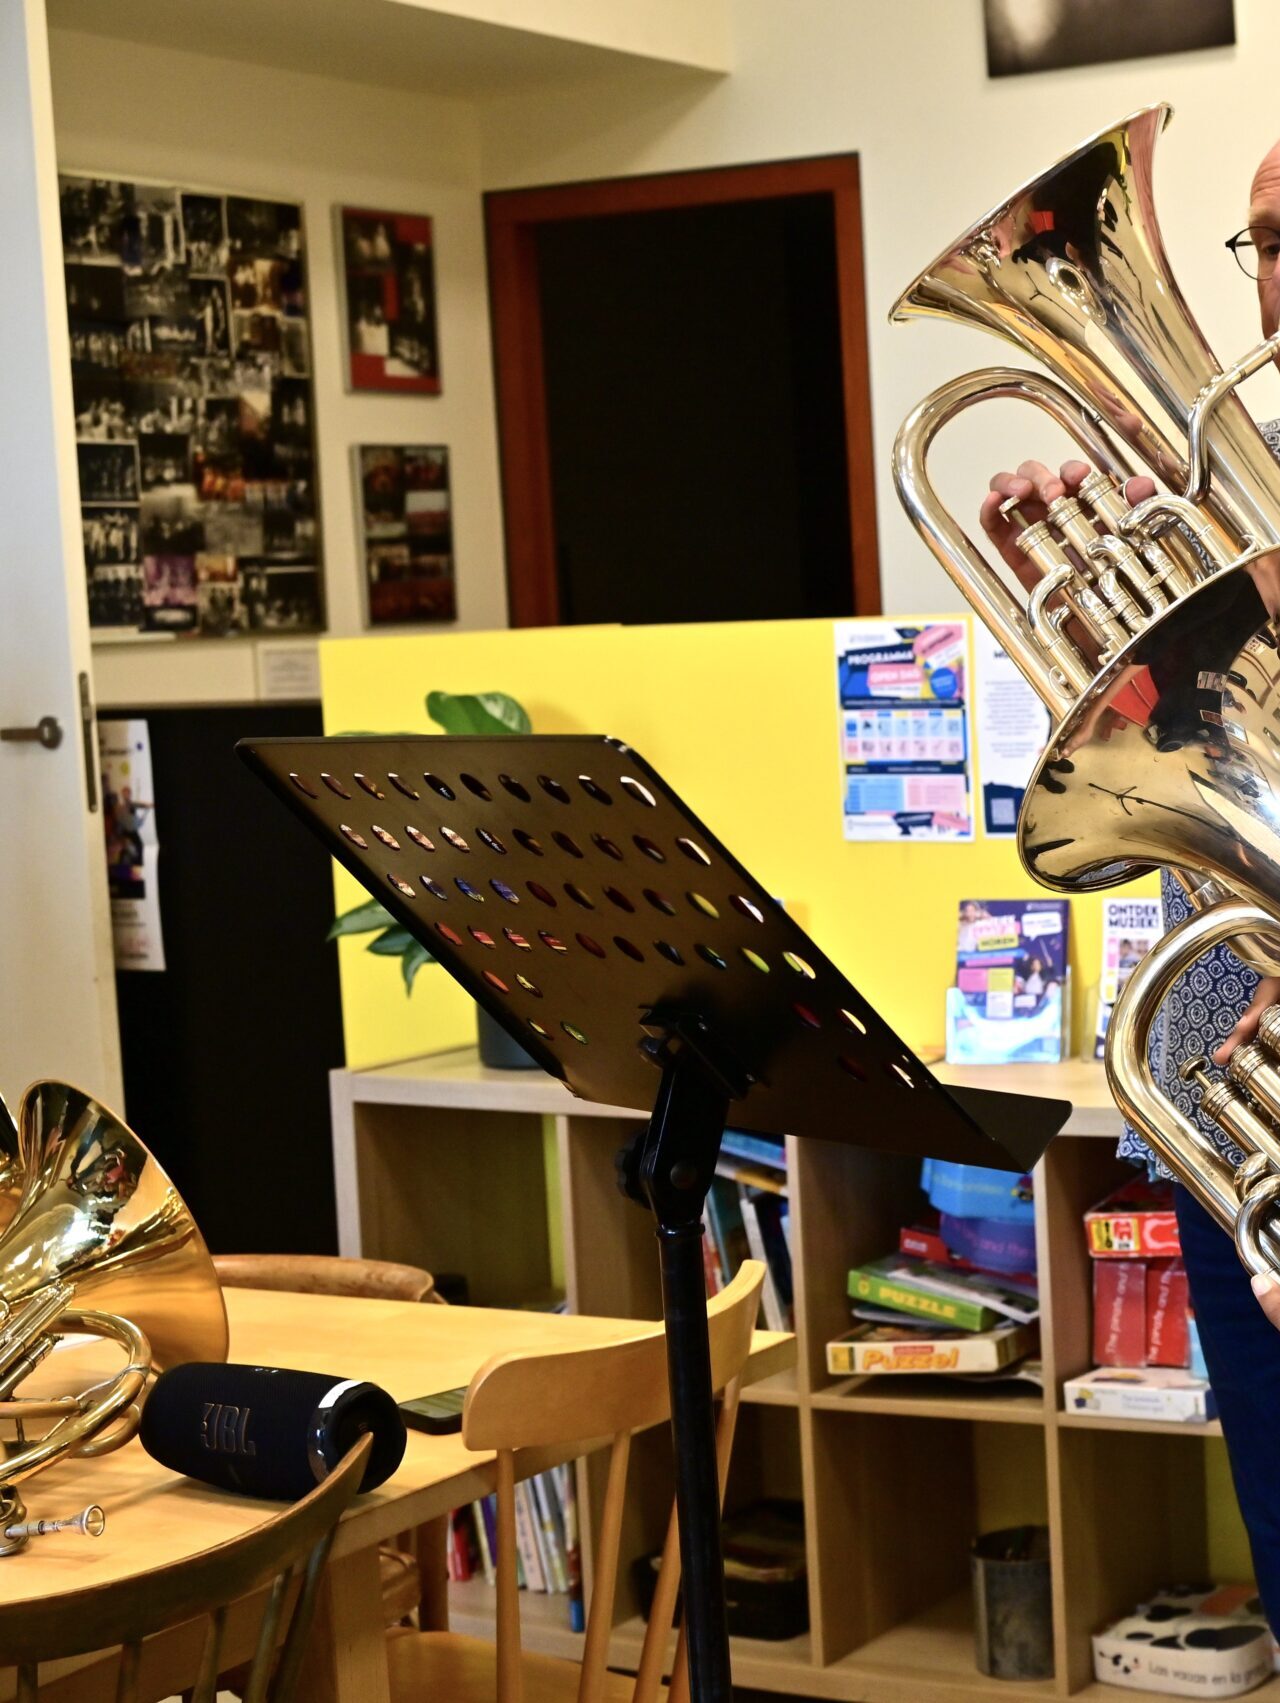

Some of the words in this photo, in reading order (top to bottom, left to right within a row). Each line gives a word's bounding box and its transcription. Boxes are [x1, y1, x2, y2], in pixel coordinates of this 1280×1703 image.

[1108, 904, 1157, 915] ONTDEK
[1108, 917, 1159, 928] MUZIEK!
[879, 1286, 957, 1319] PUZZLE
[862, 1347, 960, 1370] Puzzel
[200, 1403, 256, 1456] JBL
